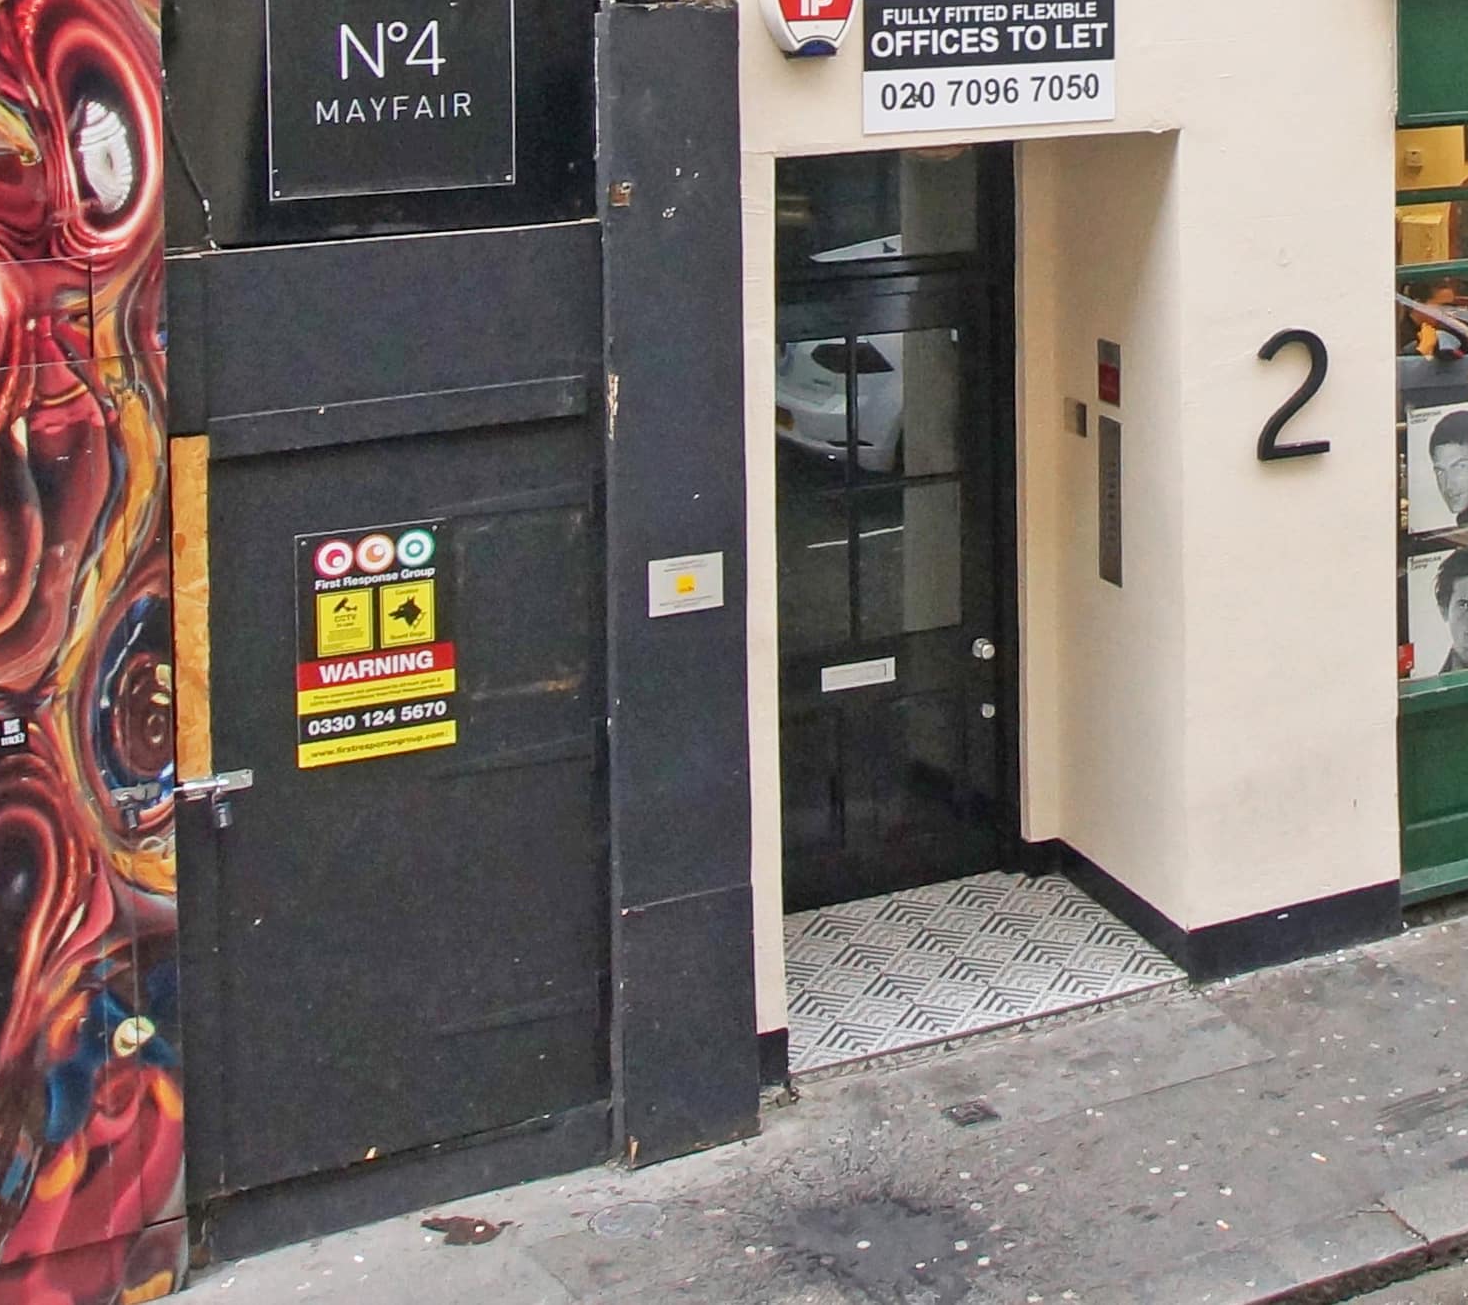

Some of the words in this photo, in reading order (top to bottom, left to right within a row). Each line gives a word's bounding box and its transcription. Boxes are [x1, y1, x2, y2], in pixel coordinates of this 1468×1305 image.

[882, 7, 941, 26] FULLY
[944, 4, 1008, 24] FITTED
[1011, 1, 1098, 21] FLEXIBLE
[870, 25, 999, 58] OFFICES
[1007, 24, 1047, 52] TO
[1054, 22, 1109, 50] LET
[315, 92, 473, 126] MAYFAIR
[881, 81, 935, 111] 020
[947, 77, 1020, 107] 7096
[1030, 73, 1100, 102] 7050
[1257, 327, 1331, 462] 2
[314, 579, 341, 591] First
[343, 571, 399, 587] Response
[401, 566, 436, 580] Group
[318, 649, 435, 684] WARNING
[307, 714, 356, 736] 0330
[361, 708, 396, 729] 124
[400, 699, 448, 722] 5670
